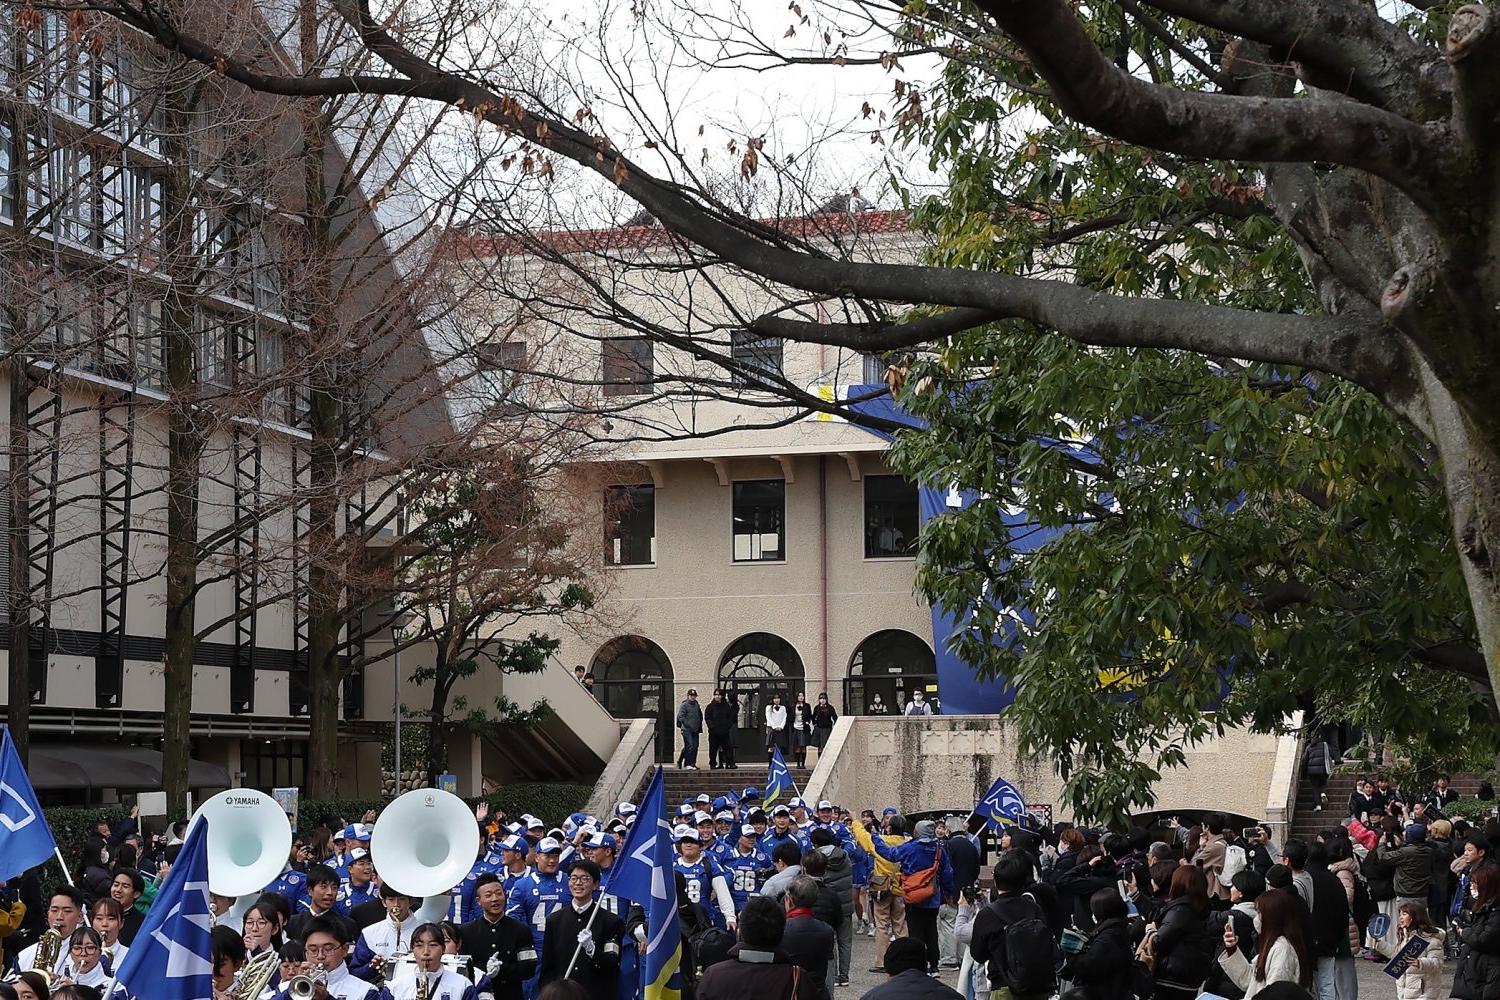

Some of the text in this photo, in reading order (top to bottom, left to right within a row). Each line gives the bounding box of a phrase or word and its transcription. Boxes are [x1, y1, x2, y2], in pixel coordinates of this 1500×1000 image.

[234, 797, 260, 805] YAMAHA
[685, 879, 701, 904] 8
[733, 870, 756, 892] 36
